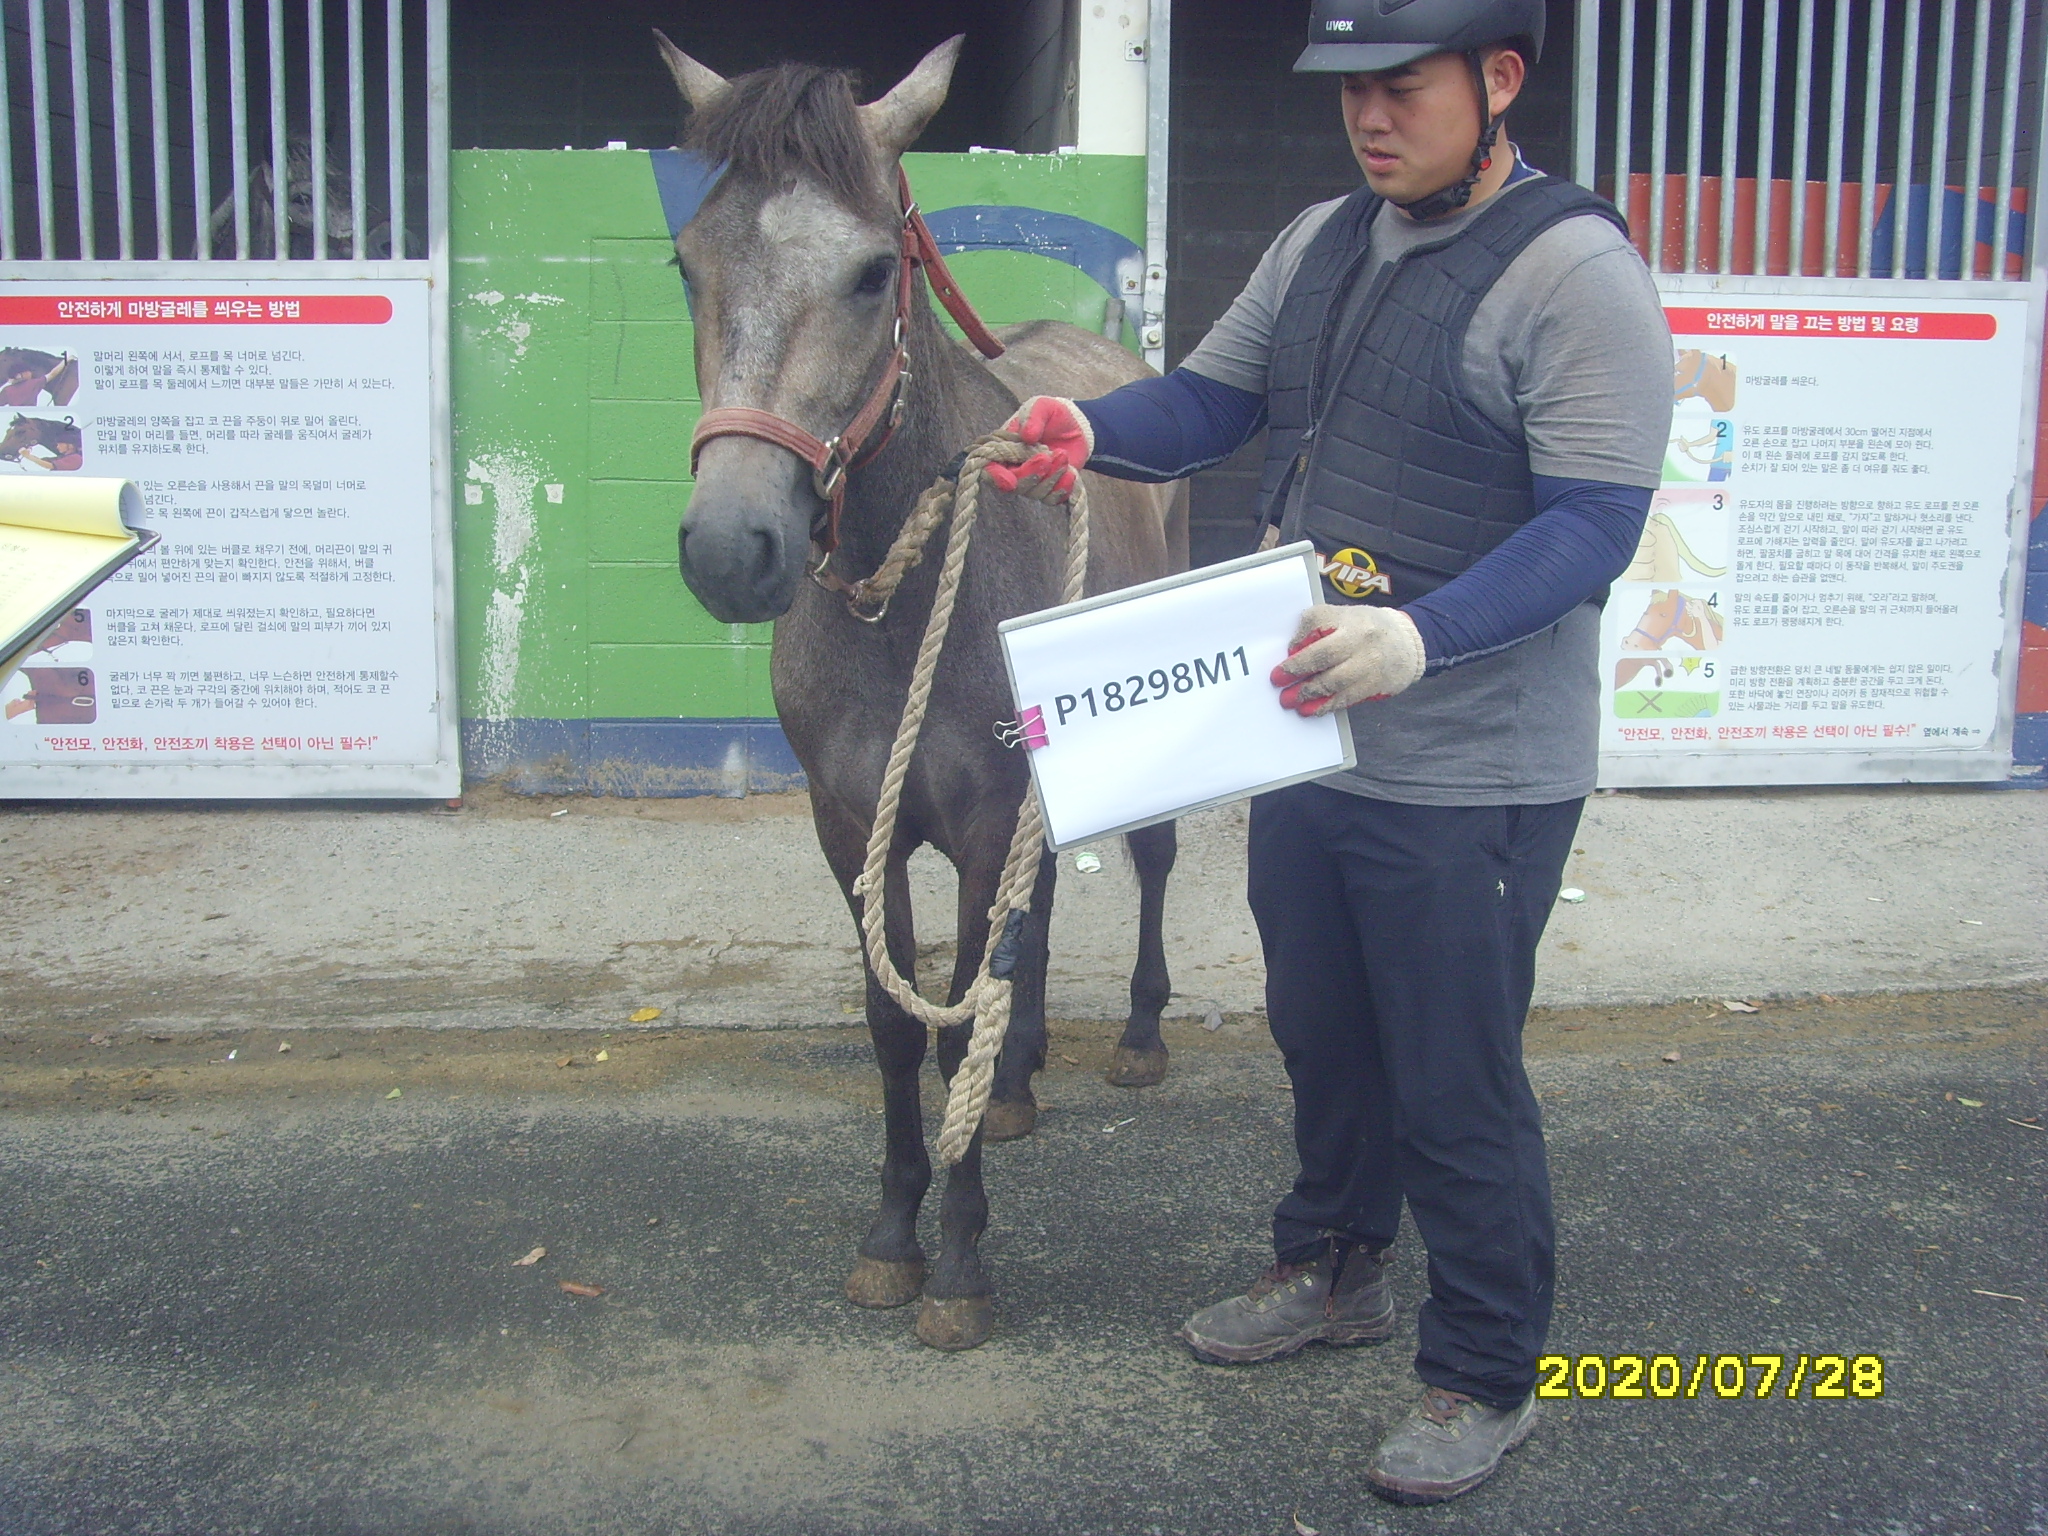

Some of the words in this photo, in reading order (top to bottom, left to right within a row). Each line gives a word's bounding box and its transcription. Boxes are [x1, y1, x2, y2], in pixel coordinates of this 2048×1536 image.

[1325, 19, 1354, 32] uvex
[58, 301, 121, 318] 안전하게
[128, 301, 208, 318] 마방굴레를
[214, 301, 263, 318] 씌우는
[269, 300, 300, 318] 방법
[1707, 312, 1764, 330] 안전하게
[1770, 314, 1799, 330] 말을
[1803, 315, 1833, 331] 끄는
[1837, 315, 1866, 332] 방법
[1871, 316, 1885, 332] 및
[1890, 316, 1918, 333] 요령
[61, 351, 68, 366] 1
[93, 350, 123, 362] 말머리
[128, 350, 158, 362] 왼쪽에
[162, 350, 185, 362] 서서,
[189, 350, 219, 361] 로프를
[223, 350, 233, 361] 목
[237, 350, 267, 361] 너머로
[271, 350, 304, 361] 넘긴다.
[1719, 354, 1728, 370] 1
[94, 365, 124, 376] 이렇게
[128, 365, 148, 376] 하여
[152, 364, 172, 375] 말을
[176, 364, 196, 375] 즉시
[200, 364, 230, 376] 통제할
[234, 365, 244, 375] 수
[248, 364, 271, 375] 있다.
[94, 378, 115, 390] 말이
[118, 378, 149, 390] 로프를
[152, 378, 163, 389] 목
[166, 378, 207, 390] 둘레에서
[211, 378, 241, 389] 느끼면
[245, 378, 275, 389] 대부분
[279, 378, 309, 389] 말들은
[314, 378, 343, 389] 가만히
[348, 378, 357, 389] 서
[361, 378, 394, 389] 있는다.
[1745, 375, 1788, 386] 마방굴레를
[1791, 375, 1819, 386] 씌운다.
[64, 415, 74, 431] 2
[96, 416, 146, 427] 마방굴레의
[150, 415, 180, 427] 양쪽을
[184, 416, 205, 427] 잡고
[208, 416, 218, 425] 코
[222, 415, 242, 426] 끈을
[246, 415, 276, 427] 주둥이
[280, 415, 300, 426] 위로
[304, 415, 324, 426] 밀어
[328, 415, 361, 426] 올린다.
[96, 430, 117, 441] 만일
[120, 430, 141, 441] 말이
[145, 429, 175, 440] 머리를
[178, 429, 202, 441] 들면,
[206, 429, 236, 440] 머리를
[240, 429, 260, 440] 따라
[263, 429, 293, 440] 굴레를
[297, 429, 337, 440] 움직여서
[341, 429, 372, 440] 굴레가
[1716, 422, 1728, 438] 2
[1743, 425, 1760, 435] 유도
[1763, 426, 1788, 435] 로프를
[1791, 426, 1842, 436] 마방굴레에서
[1845, 427, 1868, 436] 30cm
[1871, 427, 1896, 437] 떨어진
[1898, 428, 1932, 437] 지점에서
[98, 443, 127, 455] 위치를
[131, 443, 182, 454] 유지하도록
[186, 443, 208, 454] 한다.
[1839, 438, 1864, 449] 부분을
[1713, 495, 1724, 510] 3
[1316, 553, 1392, 595] VIPA
[1707, 592, 1718, 608] 4
[74, 609, 85, 623] 5
[106, 608, 156, 619] 마지막으로
[159, 608, 189, 619] 굴레가
[192, 608, 223, 618] 제대로
[279, 607, 322, 619] 확인하고,
[326, 608, 375, 618] 필요하다면
[107, 621, 136, 632] 버클을
[140, 622, 160, 632] 고쳐
[163, 621, 196, 632] 채운다.
[200, 621, 229, 632] 로프에
[233, 621, 253, 632] 달린
[257, 621, 286, 632] 걸쇠에
[290, 621, 310, 632] 말의
[314, 621, 344, 632] 피부가
[347, 621, 367, 632] 끼어
[371, 621, 391, 632] 있지
[107, 635, 137, 646] 않은지
[141, 635, 183, 646] 확인한다.
[109, 671, 139, 682] 굴레가
[143, 671, 162, 682] 너무
[180, 671, 199, 682] 끼면
[203, 671, 245, 682] 불편하고,
[250, 671, 269, 681] 너무
[272, 670, 312, 681] 느슨하면
[316, 670, 355, 681] 안전하게
[359, 670, 399, 681] 통제할수
[1704, 662, 1715, 678] 5
[78, 671, 89, 686] 6
[110, 684, 133, 695] 없다.
[137, 685, 147, 694] 코
[150, 684, 170, 695] 끈은
[173, 684, 193, 695] 눈과
[230, 684, 259, 695] 중간에
[264, 684, 303, 695] 위치해야
[307, 684, 329, 695] 하며,
[333, 684, 363, 695] 적어도
[367, 684, 376, 693] 코
[380, 684, 390, 694] 끈
[1055, 645, 1251, 726] P18298M1
[111, 698, 141, 708] 밑으로
[144, 698, 173, 708] 손가락
[177, 698, 187, 708] 두
[191, 698, 211, 708] 개가
[214, 698, 244, 708] 들어갈
[247, 698, 257, 708] 수
[261, 697, 291, 708] 있어야
[294, 697, 317, 708] 한다.
[1618, 728, 1663, 741] “안전모,
[1671, 727, 1711, 740] 안전화,
[1718, 726, 1767, 740] 안전조끼
[1772, 725, 1808, 739] 착용은
[1814, 725, 1849, 739] 선택이
[1854, 725, 1878, 738] 아닌
[1882, 723, 1916, 738] 필수!”
[1923, 727, 1948, 737] 옆에서
[1952, 727, 1969, 736] 계속
[45, 737, 96, 751] “안전모,
[102, 737, 147, 751] 안전화,
[154, 737, 210, 751] 안전조끼
[215, 736, 256, 751] 착용은
[262, 737, 302, 751] 선택이
[307, 737, 335, 750] 아닌
[340, 736, 379, 751] 필수!”
